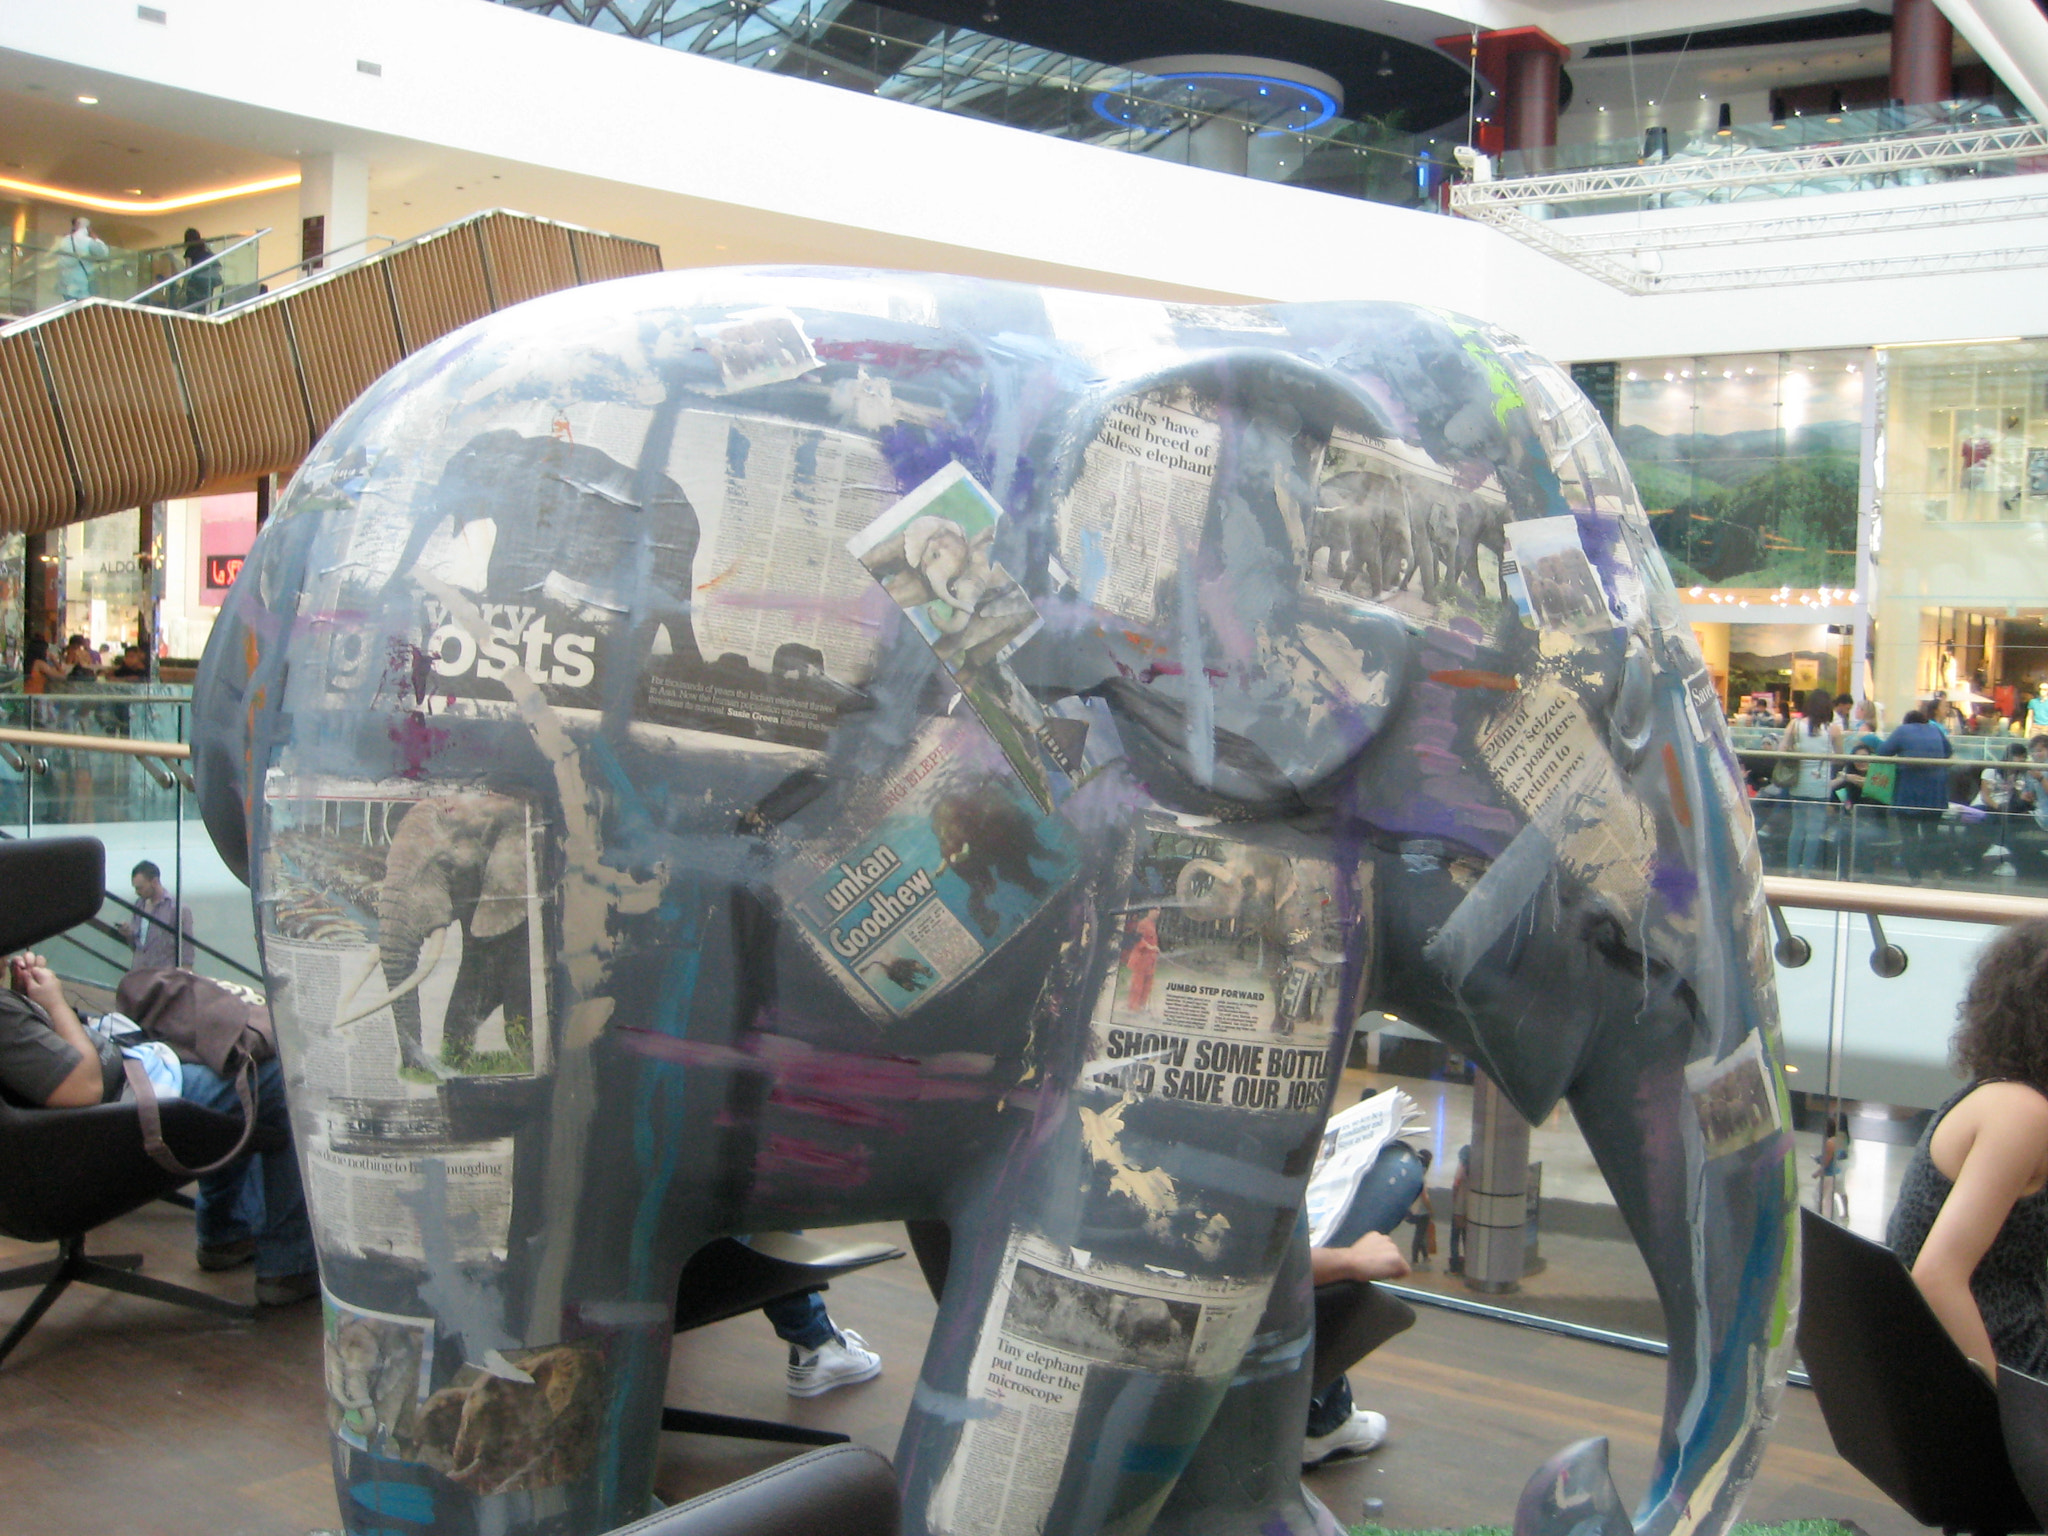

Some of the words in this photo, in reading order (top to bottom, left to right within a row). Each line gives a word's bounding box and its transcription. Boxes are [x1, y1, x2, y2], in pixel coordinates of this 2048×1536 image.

[1145, 428, 1189, 452] breed
[1194, 445, 1211, 458] of
[99, 560, 136, 574] ALDO
[727, 707, 750, 719] Susie
[752, 711, 779, 724] Green
[1494, 743, 1527, 778] ivory
[1510, 776, 1525, 793] as
[1522, 711, 1577, 779] poachers
[1522, 760, 1559, 808] return
[1555, 745, 1571, 761] to
[805, 844, 899, 919] unkan
[829, 868, 933, 958] Goodhew
[1166, 982, 1198, 993] JUMBO
[1199, 986, 1219, 996] STEP
[1221, 989, 1265, 1001] FORWARD
[1106, 1030, 1189, 1067] SHOW
[1194, 1039, 1264, 1077] SOME
[1162, 1068, 1225, 1104] SAVE
[1231, 1076, 1281, 1109] OUR
[347, 1157, 392, 1174] nothing
[395, 1160, 407, 1173] to
[991, 1356, 1012, 1372] put
[1015, 1364, 1056, 1386] under
[1057, 1376, 1081, 1392] the
[997, 1336, 1023, 1360] Tiny
[1026, 1349, 1085, 1376] elephant
[987, 1371, 1063, 1404] microscope
